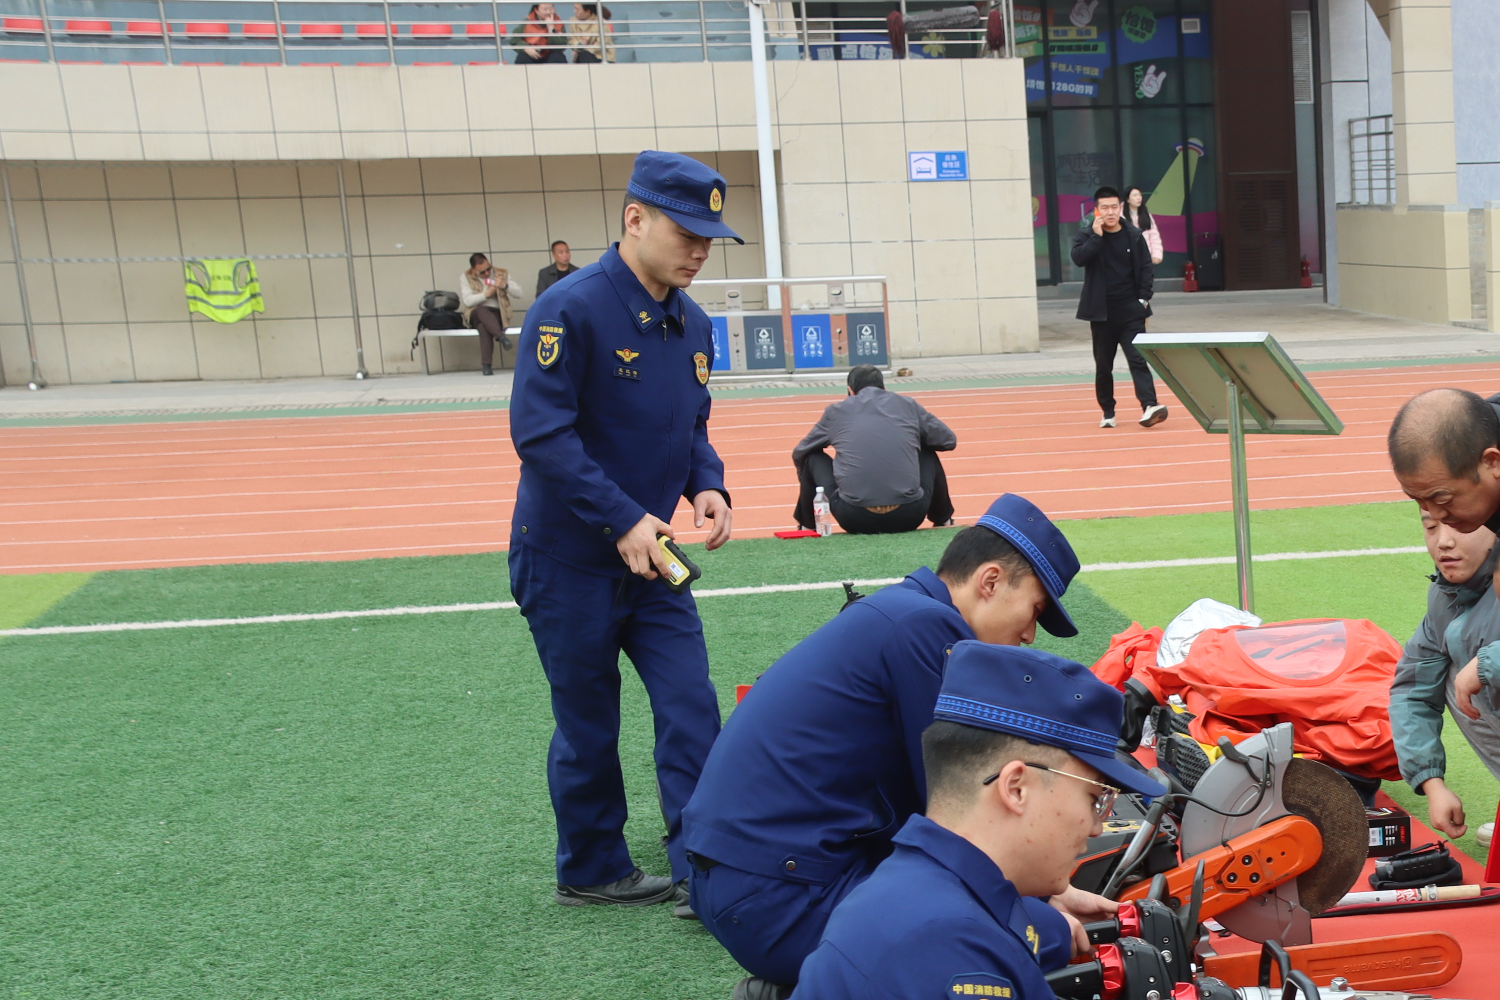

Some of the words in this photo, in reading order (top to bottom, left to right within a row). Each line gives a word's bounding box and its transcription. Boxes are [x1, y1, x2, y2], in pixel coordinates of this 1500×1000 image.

[952, 983, 1011, 998] 中国消防救援
